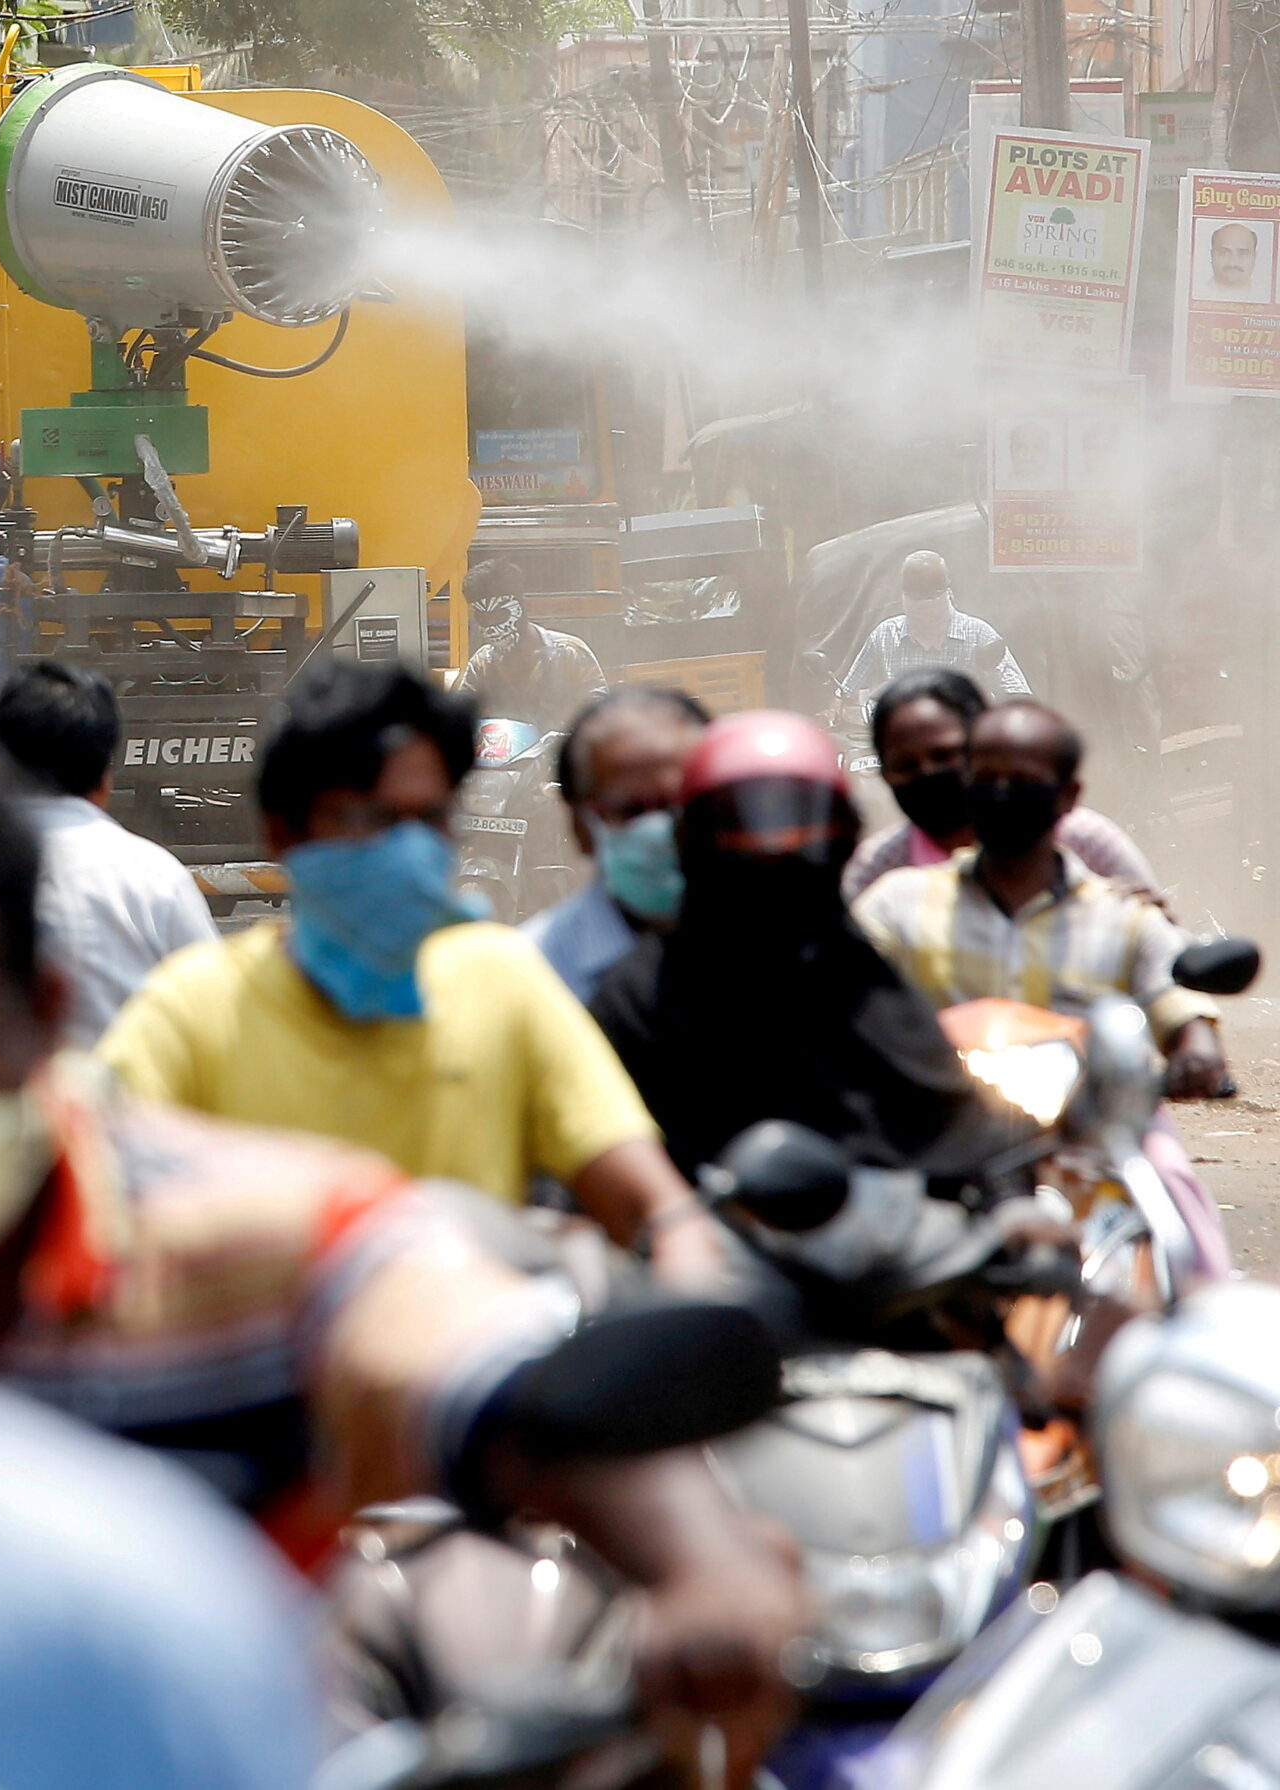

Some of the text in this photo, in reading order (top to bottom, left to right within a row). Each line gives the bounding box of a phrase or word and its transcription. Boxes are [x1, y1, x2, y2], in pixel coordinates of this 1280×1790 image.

[1009, 145, 1088, 170] PLOTS
[1095, 154, 1127, 174] AT
[1004, 166, 1124, 203] AVADI
[56, 180, 168, 221] MIST CANNON M50
[1024, 222, 1097, 245] SPRING
[1015, 279, 1050, 292] Lakhs
[1085, 286, 1120, 299] Lakhs
[1038, 312, 1095, 335] VGN
[1210, 327, 1275, 345] 96777
[1205, 356, 1274, 375] 95006
[124, 737, 257, 766] EICHER
